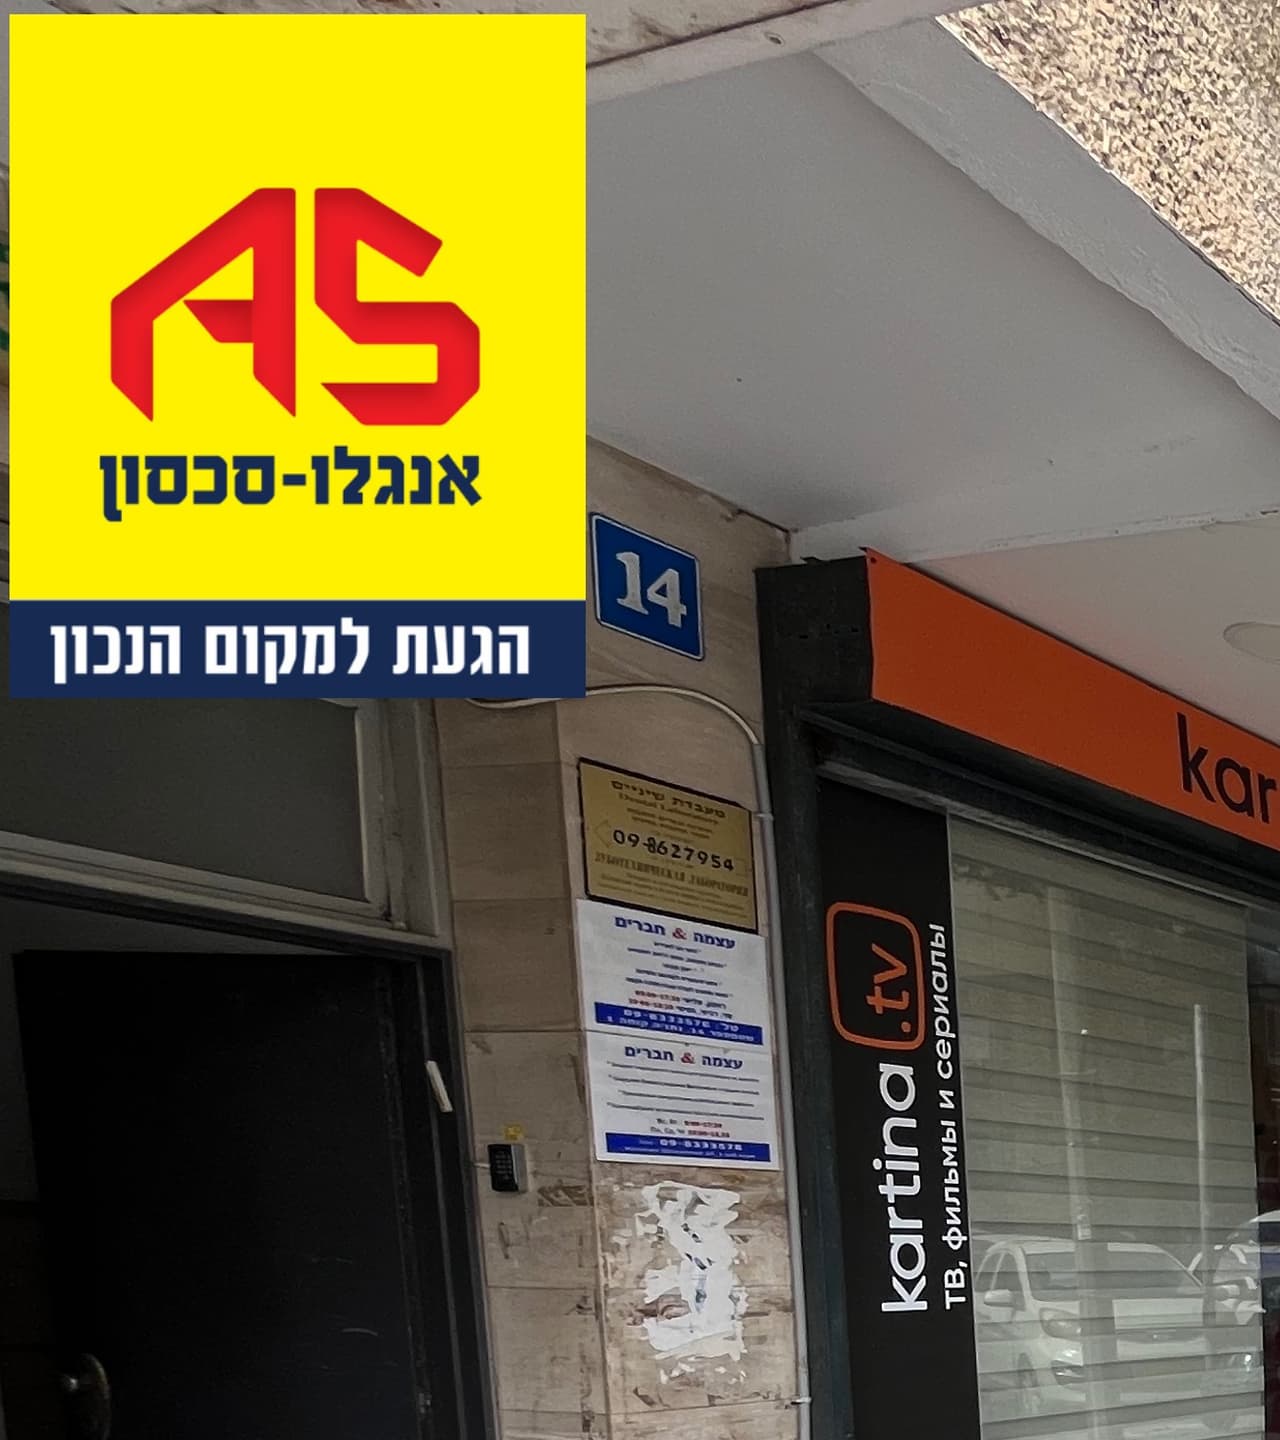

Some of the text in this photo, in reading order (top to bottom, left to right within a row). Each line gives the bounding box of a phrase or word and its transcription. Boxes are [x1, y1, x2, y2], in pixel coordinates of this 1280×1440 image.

[615, 551, 688, 629] 14
[612, 828, 735, 872] 09-8627954
[614, 916, 666, 936] חברים
[624, 1046, 674, 1062] חברים
[929, 923, 969, 1310] ТВ, фильмы и сериалы
[873, 1063, 928, 1312] kartina
